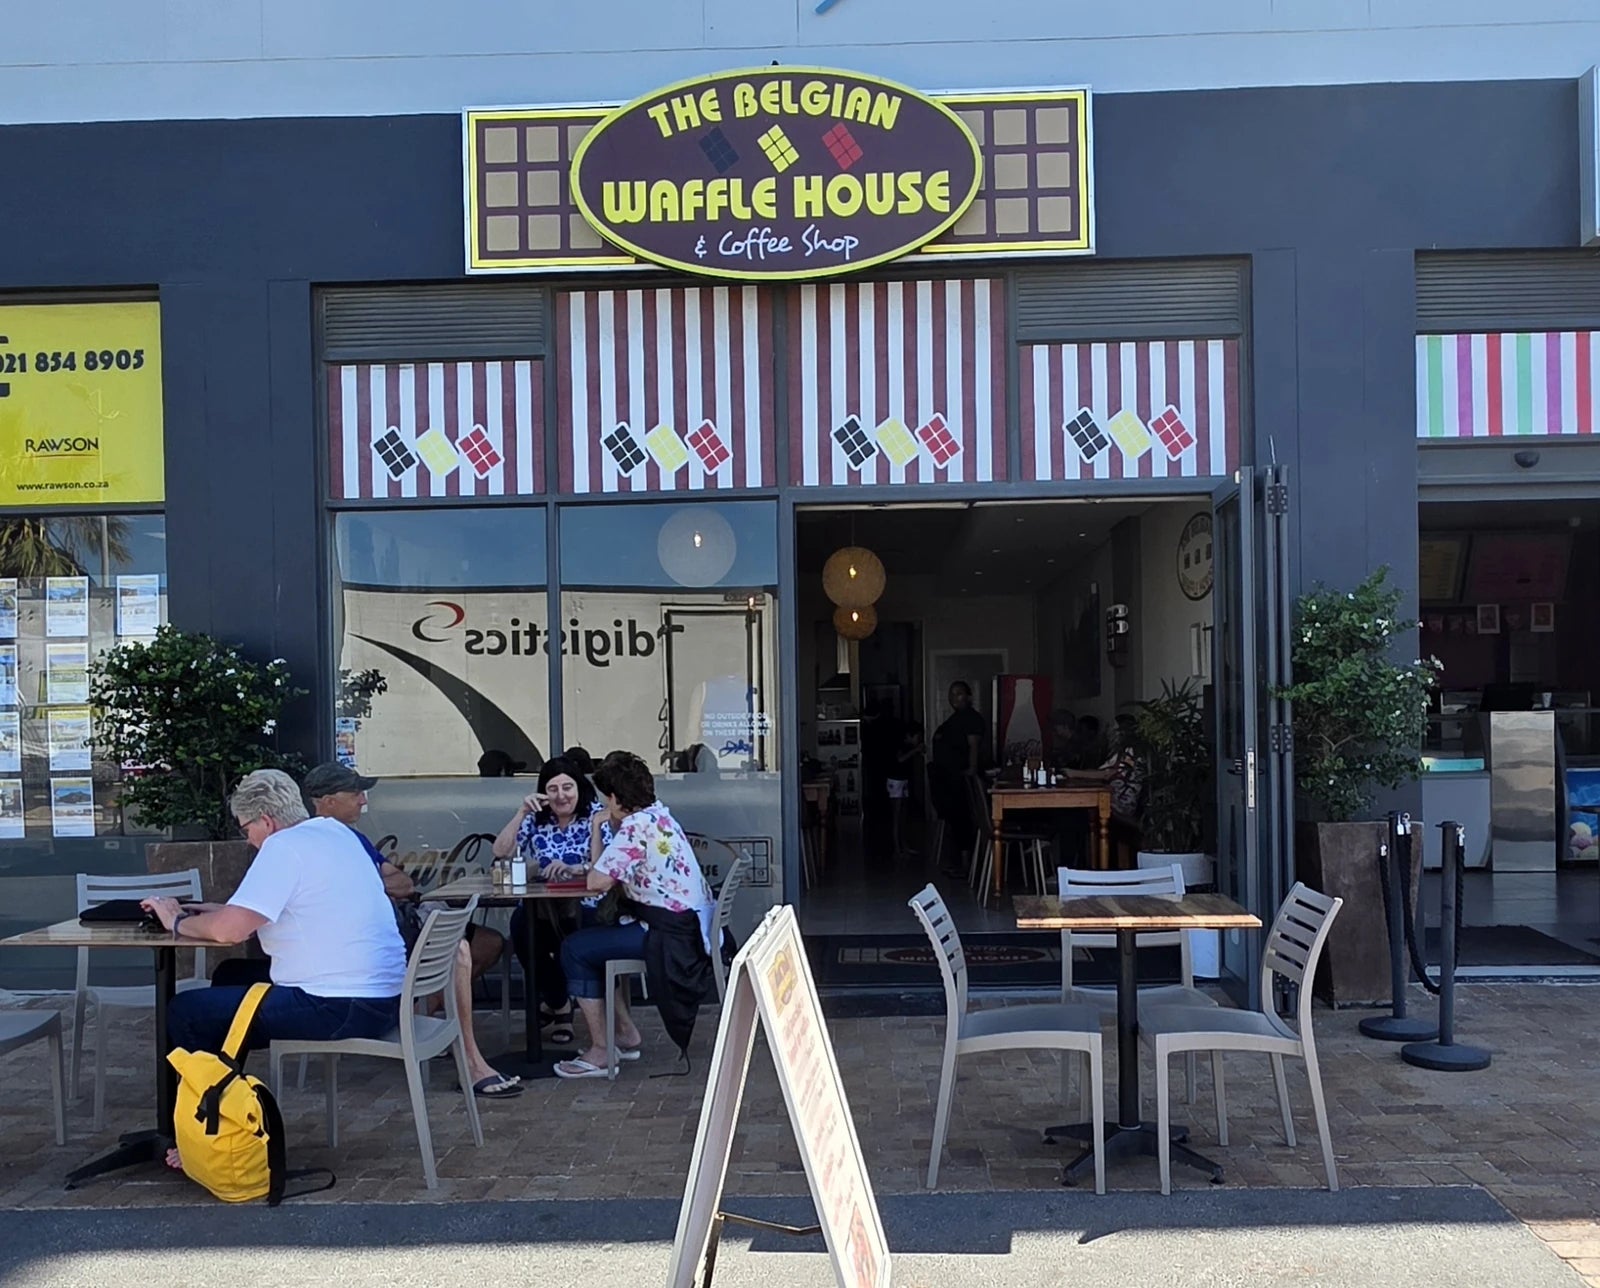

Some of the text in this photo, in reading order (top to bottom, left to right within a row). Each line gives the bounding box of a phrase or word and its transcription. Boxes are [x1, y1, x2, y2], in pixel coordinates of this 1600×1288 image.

[647, 79, 902, 139] THE BELGIAN
[602, 170, 950, 224] WAFFLE HOUSE
[694, 224, 859, 260] & Coffee Shop
[0, 349, 145, 373] 21 854 8905
[25, 437, 99, 452] RAWSON
[16, 480, 109, 491] www.rawson.co.za
